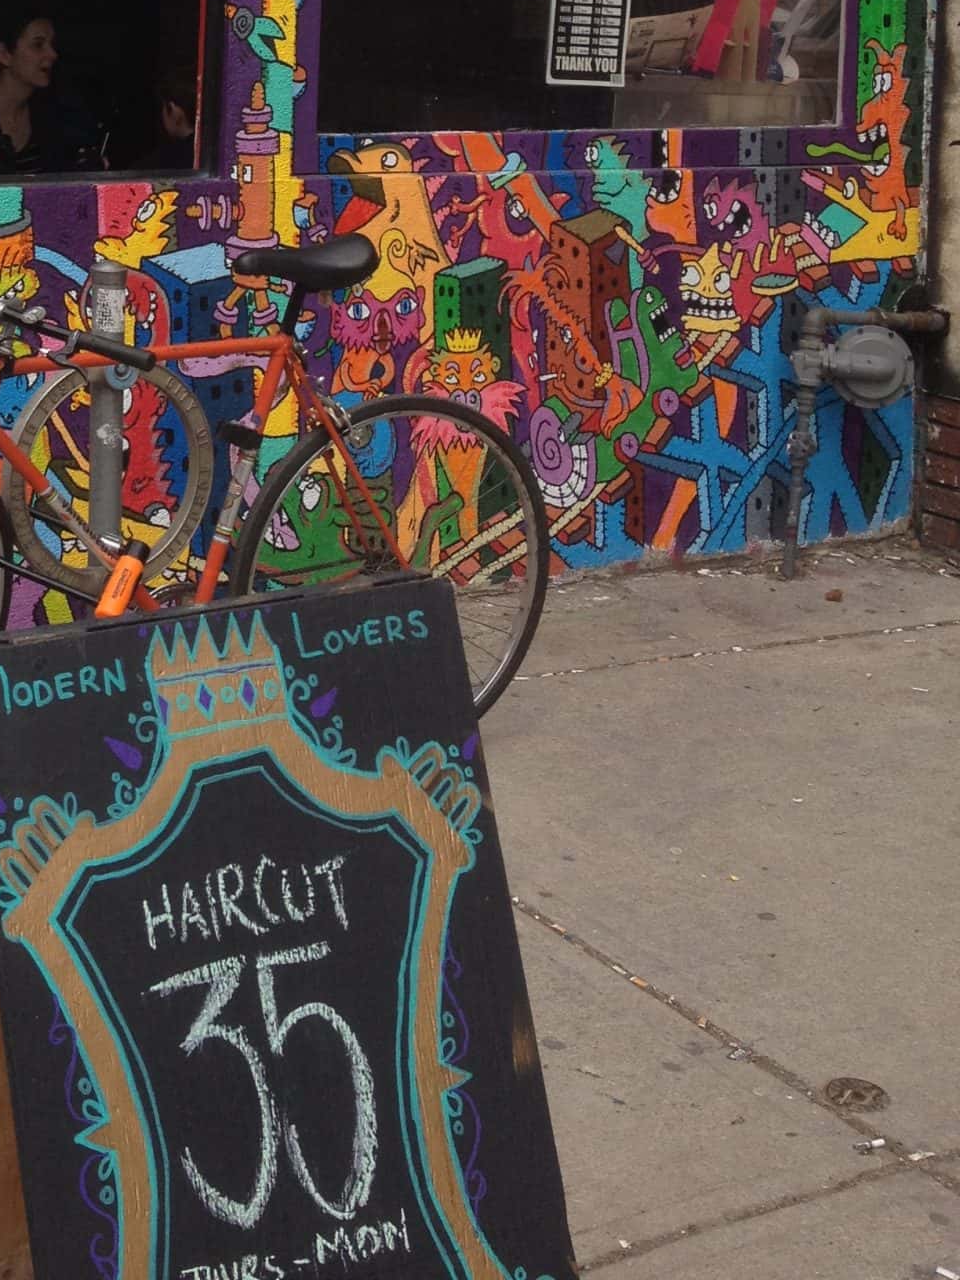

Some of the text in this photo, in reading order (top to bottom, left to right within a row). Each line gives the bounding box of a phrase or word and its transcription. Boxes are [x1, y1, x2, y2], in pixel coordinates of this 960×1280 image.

[555, 55, 618, 73] THANK YOU
[292, 609, 429, 660] LOVERS
[142, 854, 350, 950] HAIRCUT
[141, 940, 378, 1230] 35
